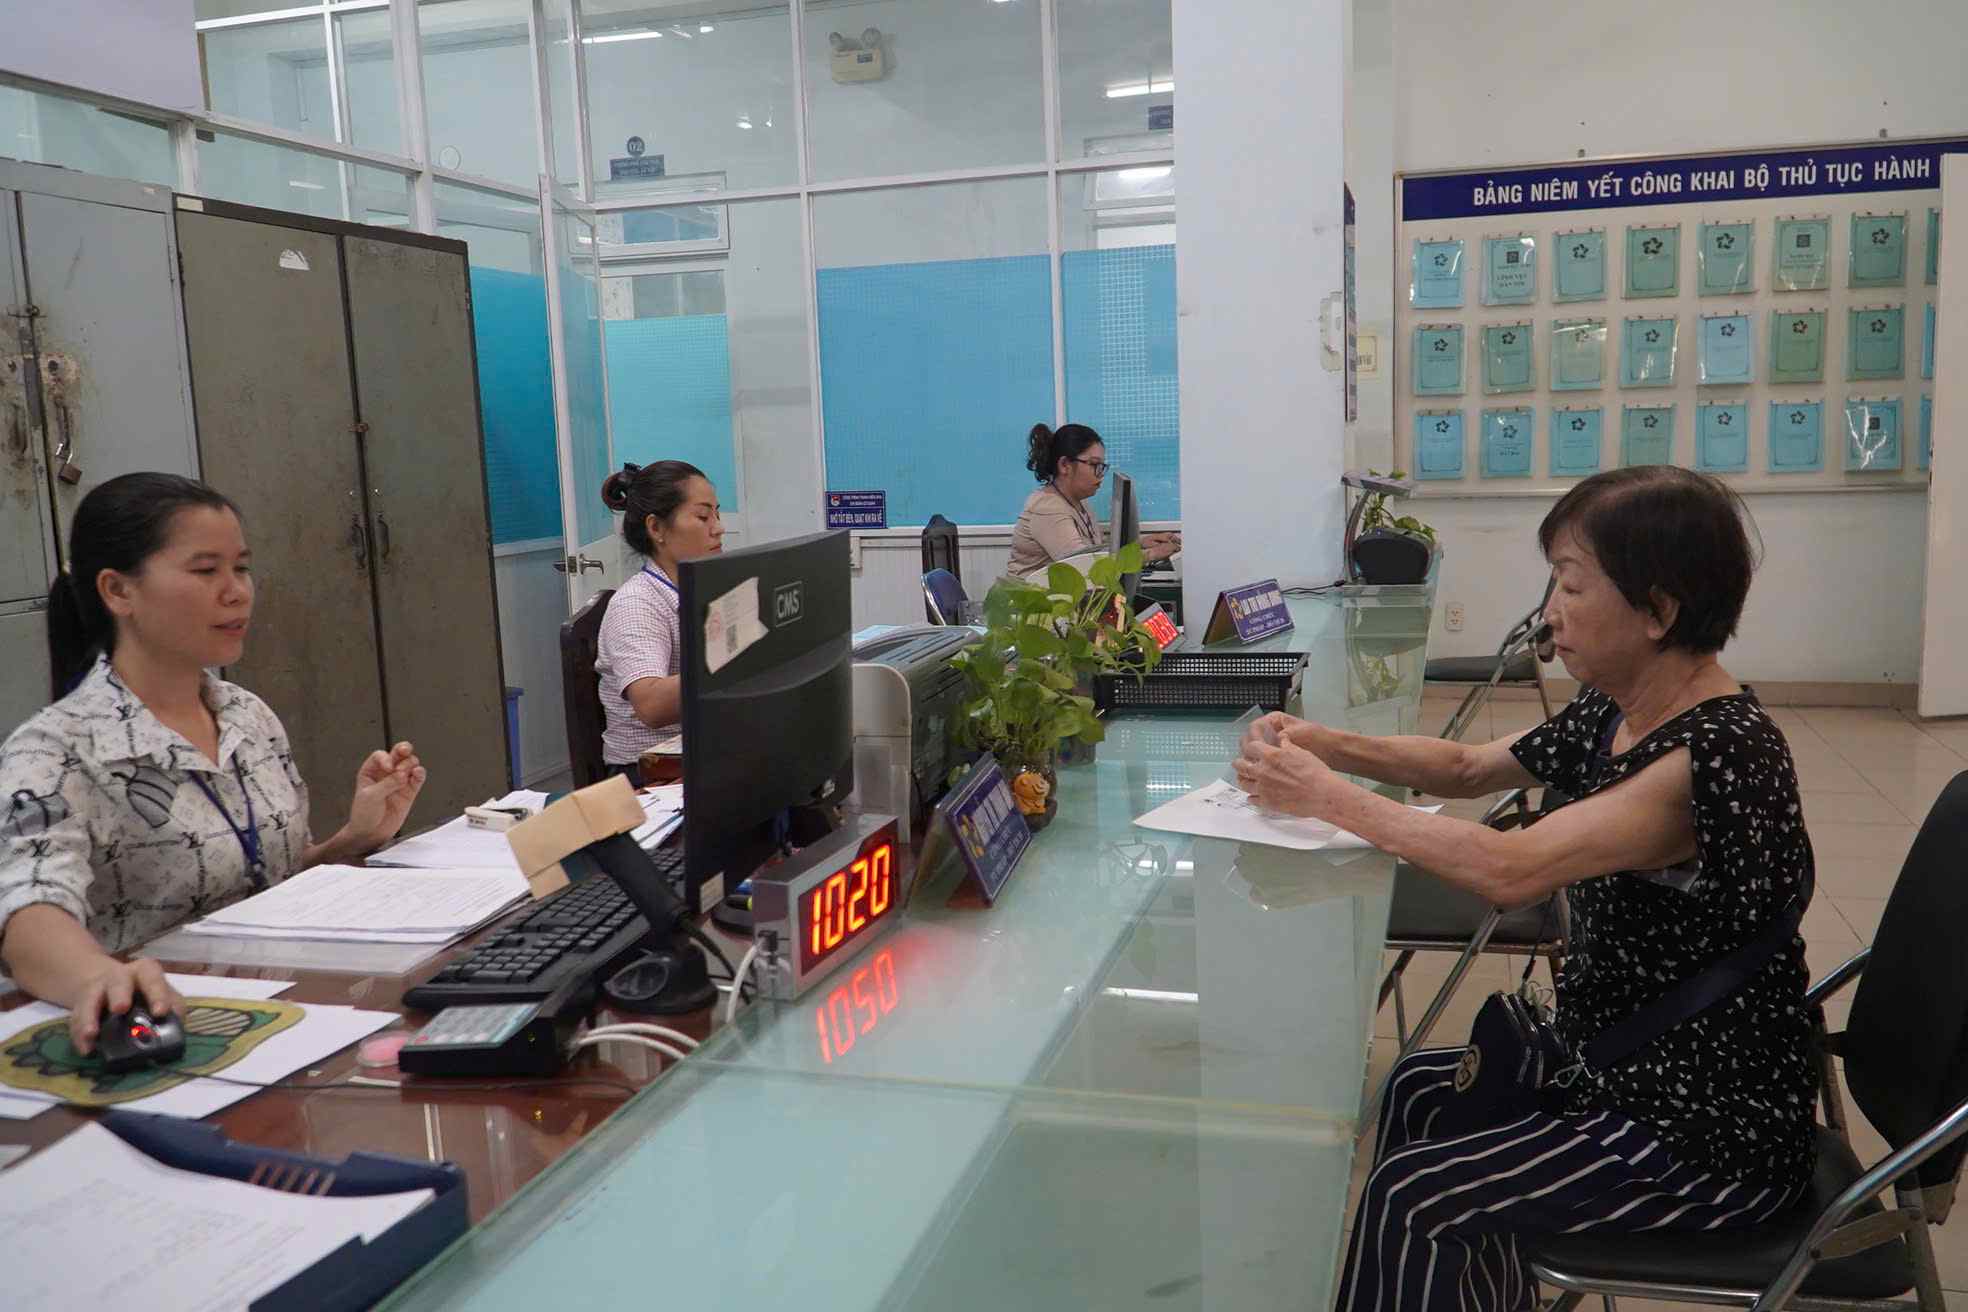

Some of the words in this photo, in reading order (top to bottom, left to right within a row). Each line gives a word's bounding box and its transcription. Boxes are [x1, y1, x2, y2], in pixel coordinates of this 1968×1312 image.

[1473, 180, 1523, 206] BẢNG
[1530, 177, 1578, 202] NIÊM
[1587, 171, 1623, 198] YẾT
[1630, 171, 1682, 196] CÔNG
[1690, 168, 1735, 191] KHAI
[1744, 162, 1769, 192] BỘ
[1779, 158, 1817, 186] THỦ
[1825, 162, 1864, 188] TỤC
[1874, 154, 1930, 181] HÀNH
[776, 589, 801, 619] CMS
[811, 844, 891, 956] 1020
